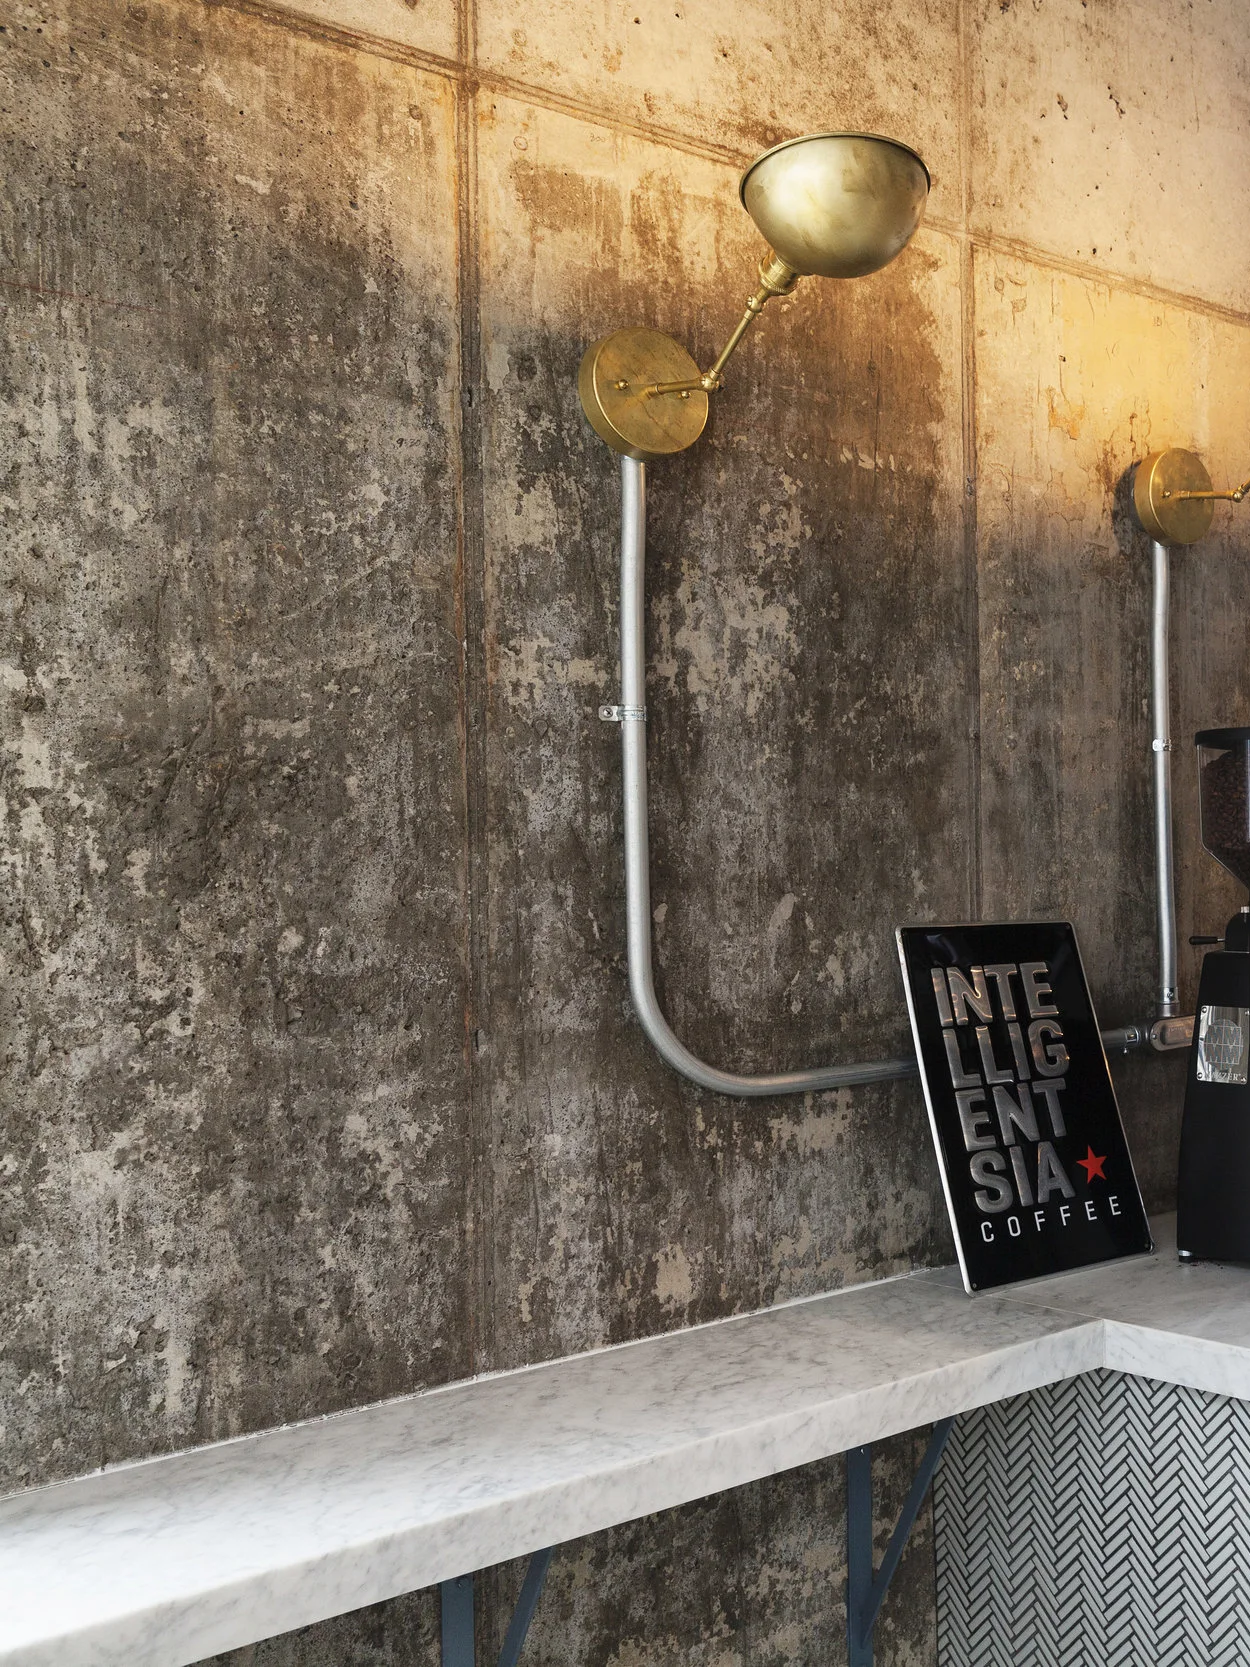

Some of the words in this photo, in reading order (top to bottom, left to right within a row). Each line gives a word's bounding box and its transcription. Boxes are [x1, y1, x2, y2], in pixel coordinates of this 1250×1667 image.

[930, 961, 1060, 1027] INTE
[954, 1078, 1067, 1152] ENT
[969, 1141, 1076, 1214] SIA
[980, 1195, 1122, 1244] COFFEE
